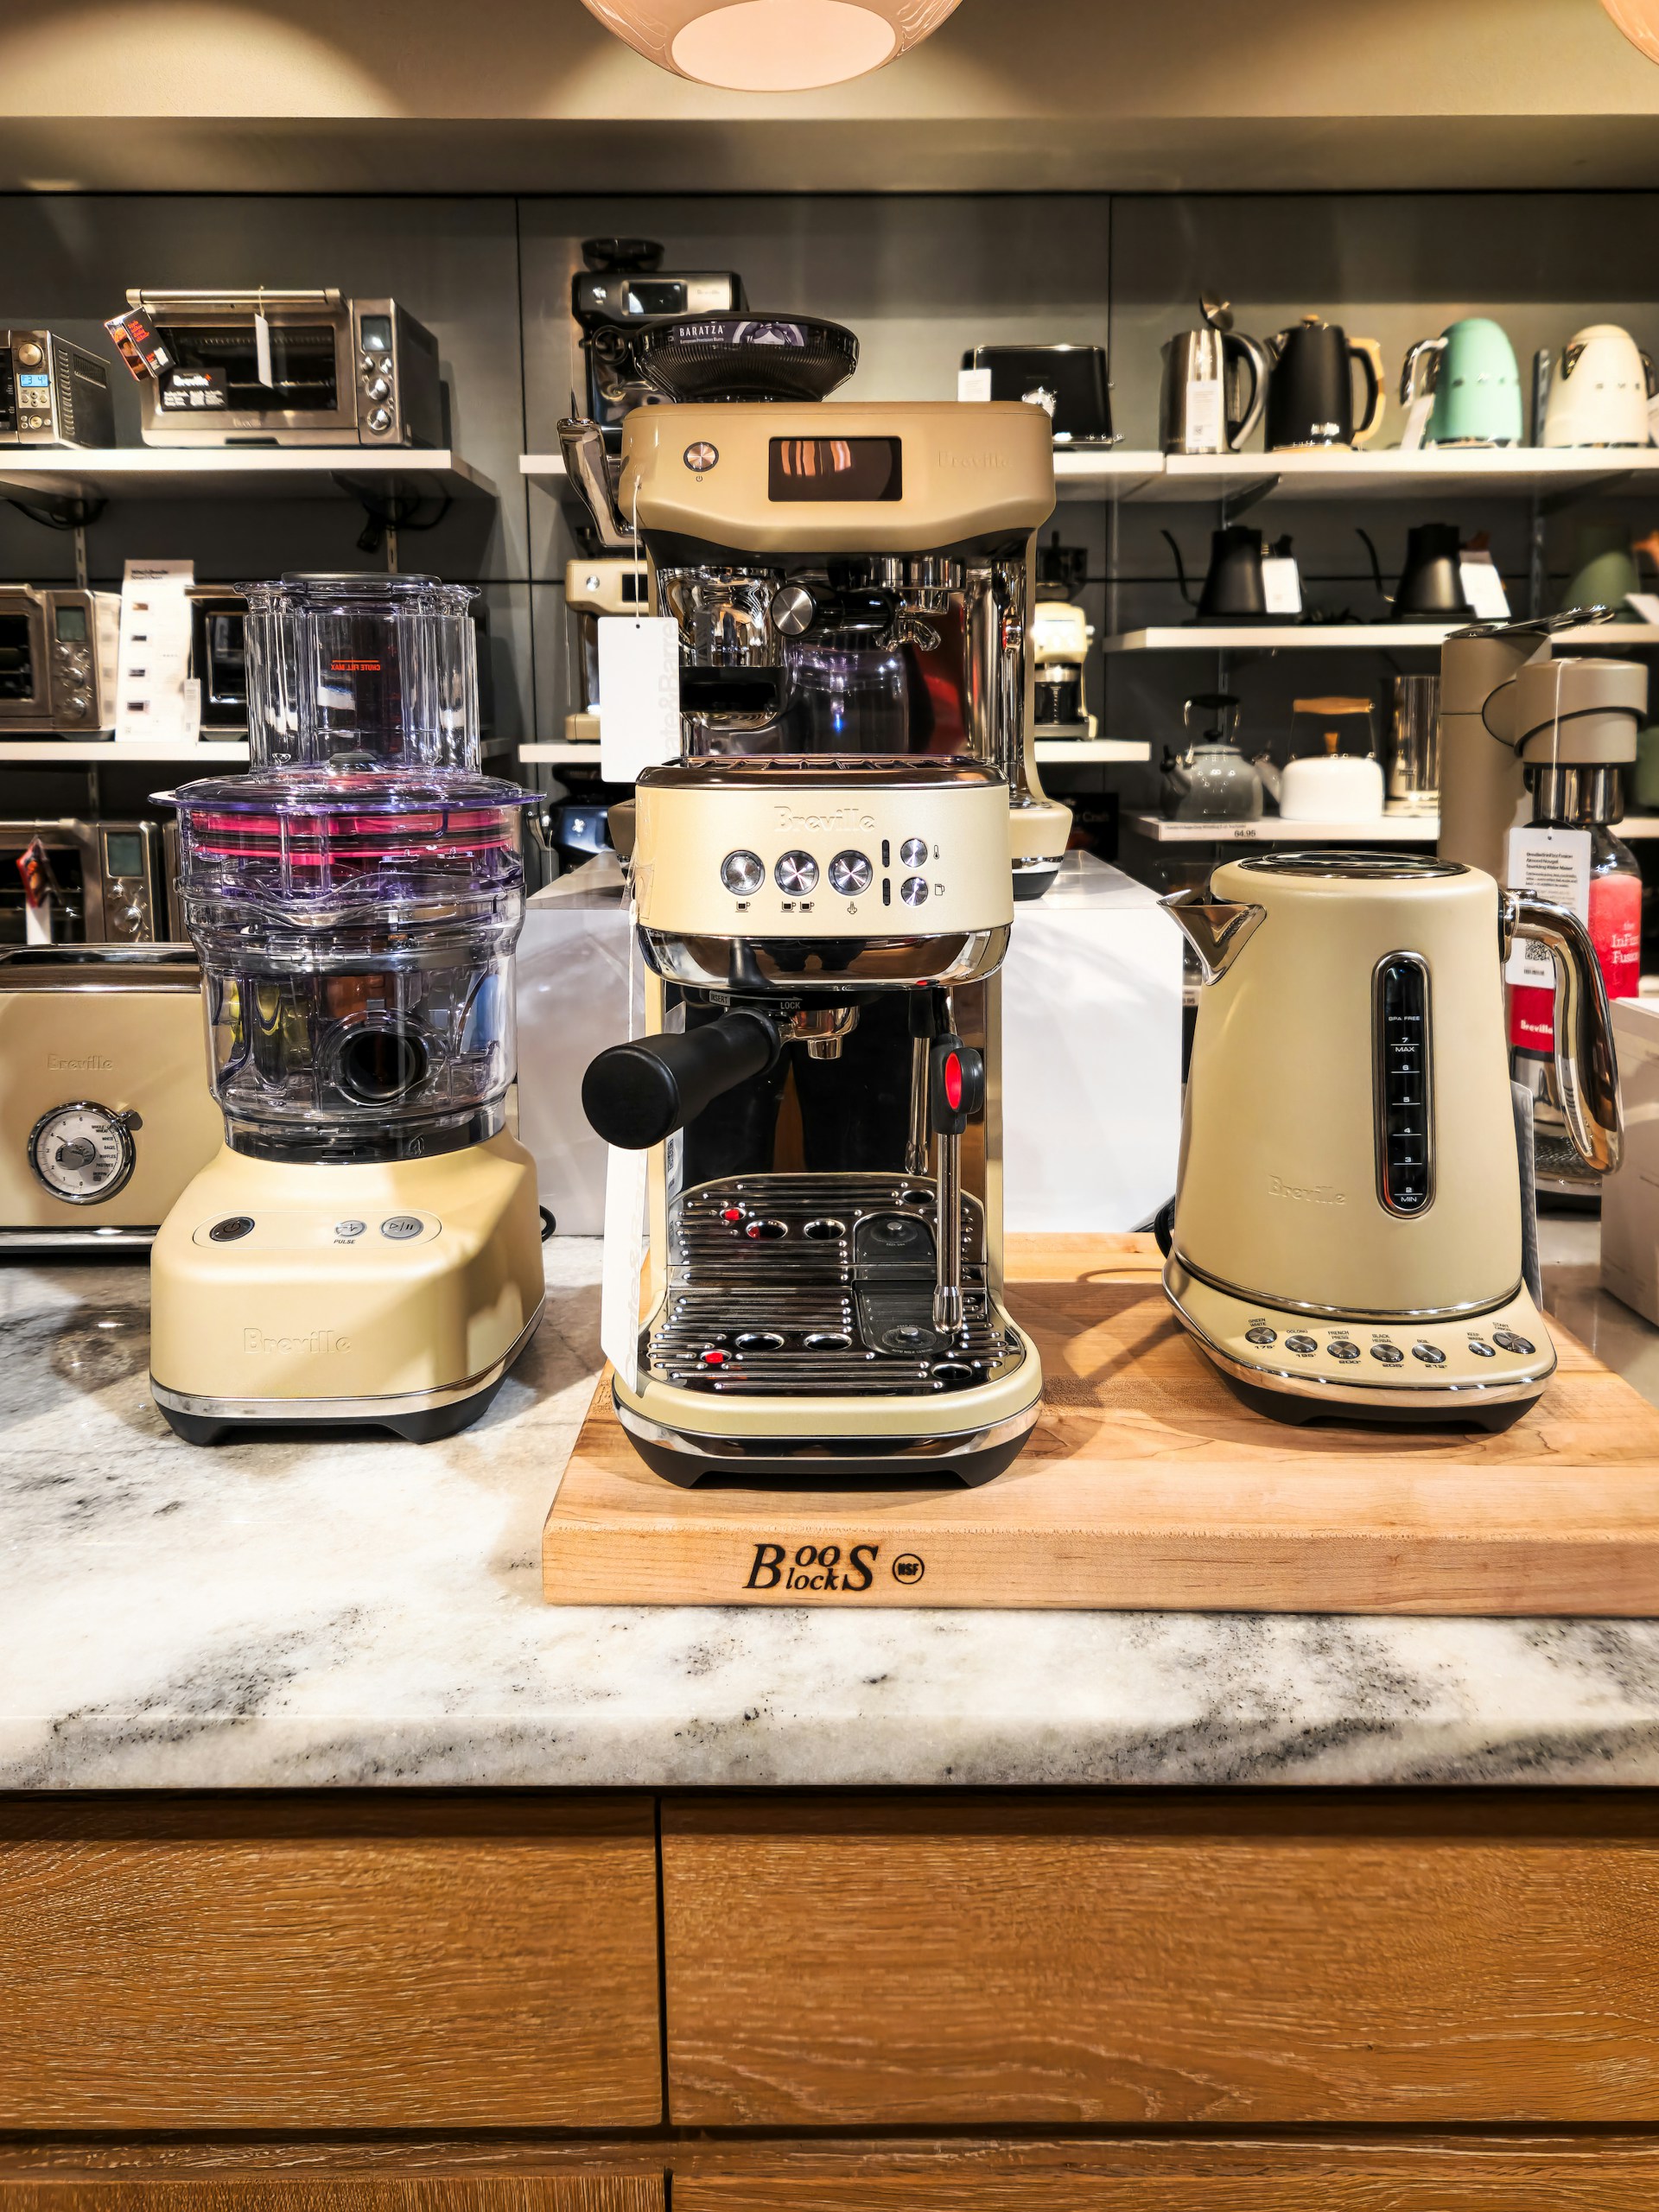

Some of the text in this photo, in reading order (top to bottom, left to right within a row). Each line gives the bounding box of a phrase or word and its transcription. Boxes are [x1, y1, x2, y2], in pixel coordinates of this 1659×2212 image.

[680, 325, 723, 336] BARATZA
[773, 805, 875, 831] Breville
[711, 994, 729, 1003] INSERT
[48, 1053, 113, 1071] Breville
[1268, 1174, 1346, 1205] Breville
[244, 1327, 352, 1354] Breville
[897, 1562, 919, 1576] NSF
